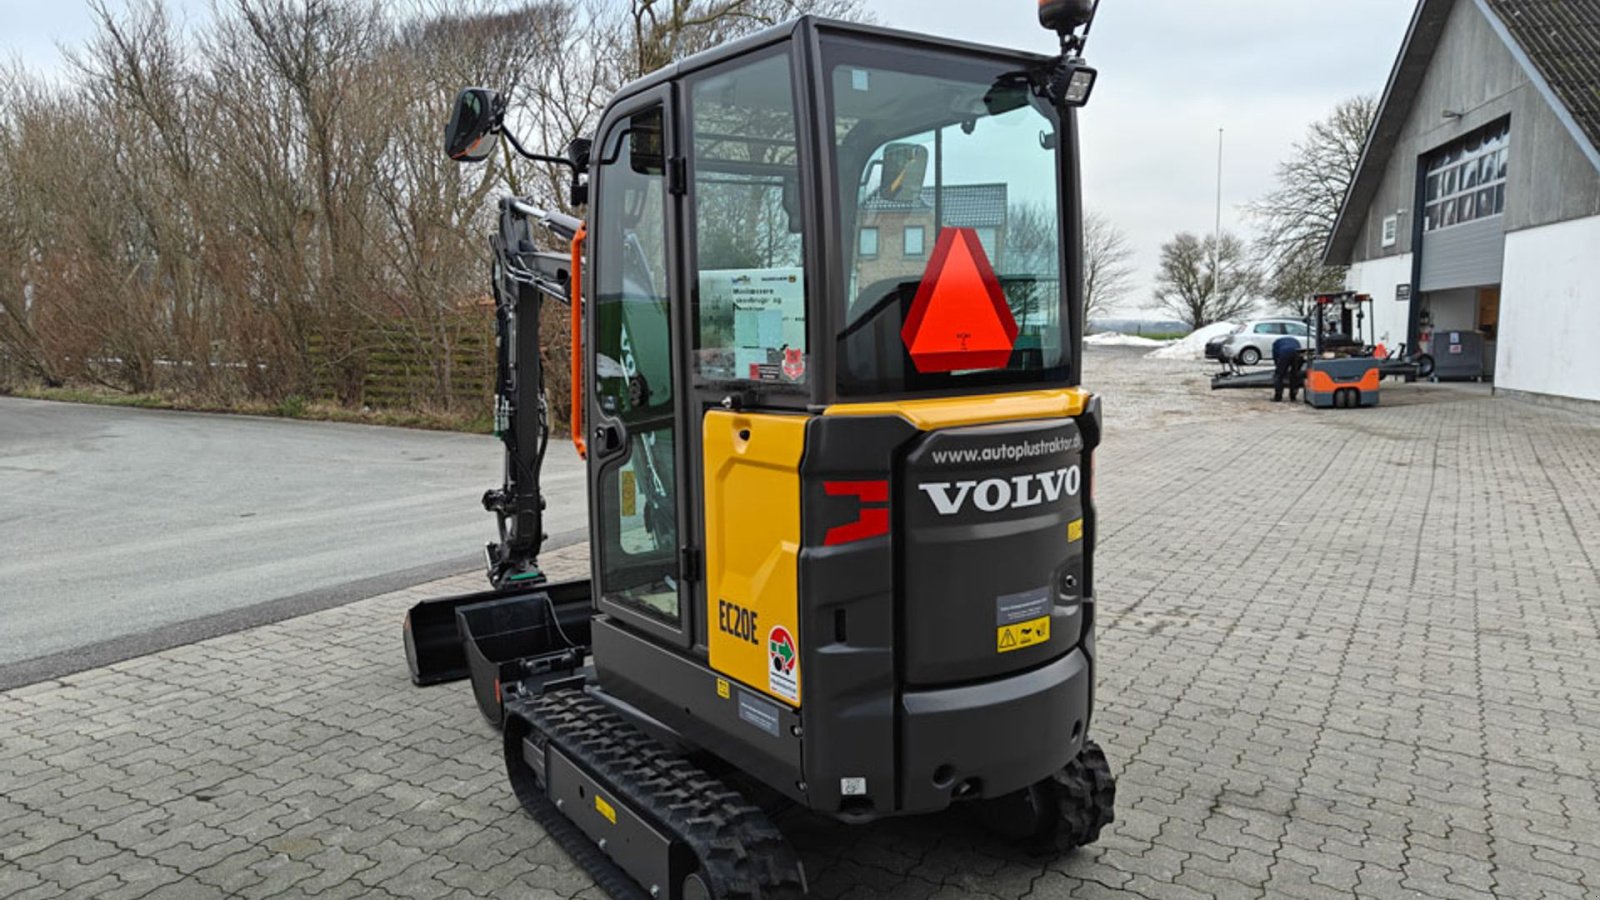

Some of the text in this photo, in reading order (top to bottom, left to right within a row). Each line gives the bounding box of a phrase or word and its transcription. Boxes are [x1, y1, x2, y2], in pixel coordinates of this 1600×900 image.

[932, 432, 1083, 464] www.autoplustraktor.d
[918, 464, 1081, 515] VOLVO
[719, 598, 759, 645] EC20E
